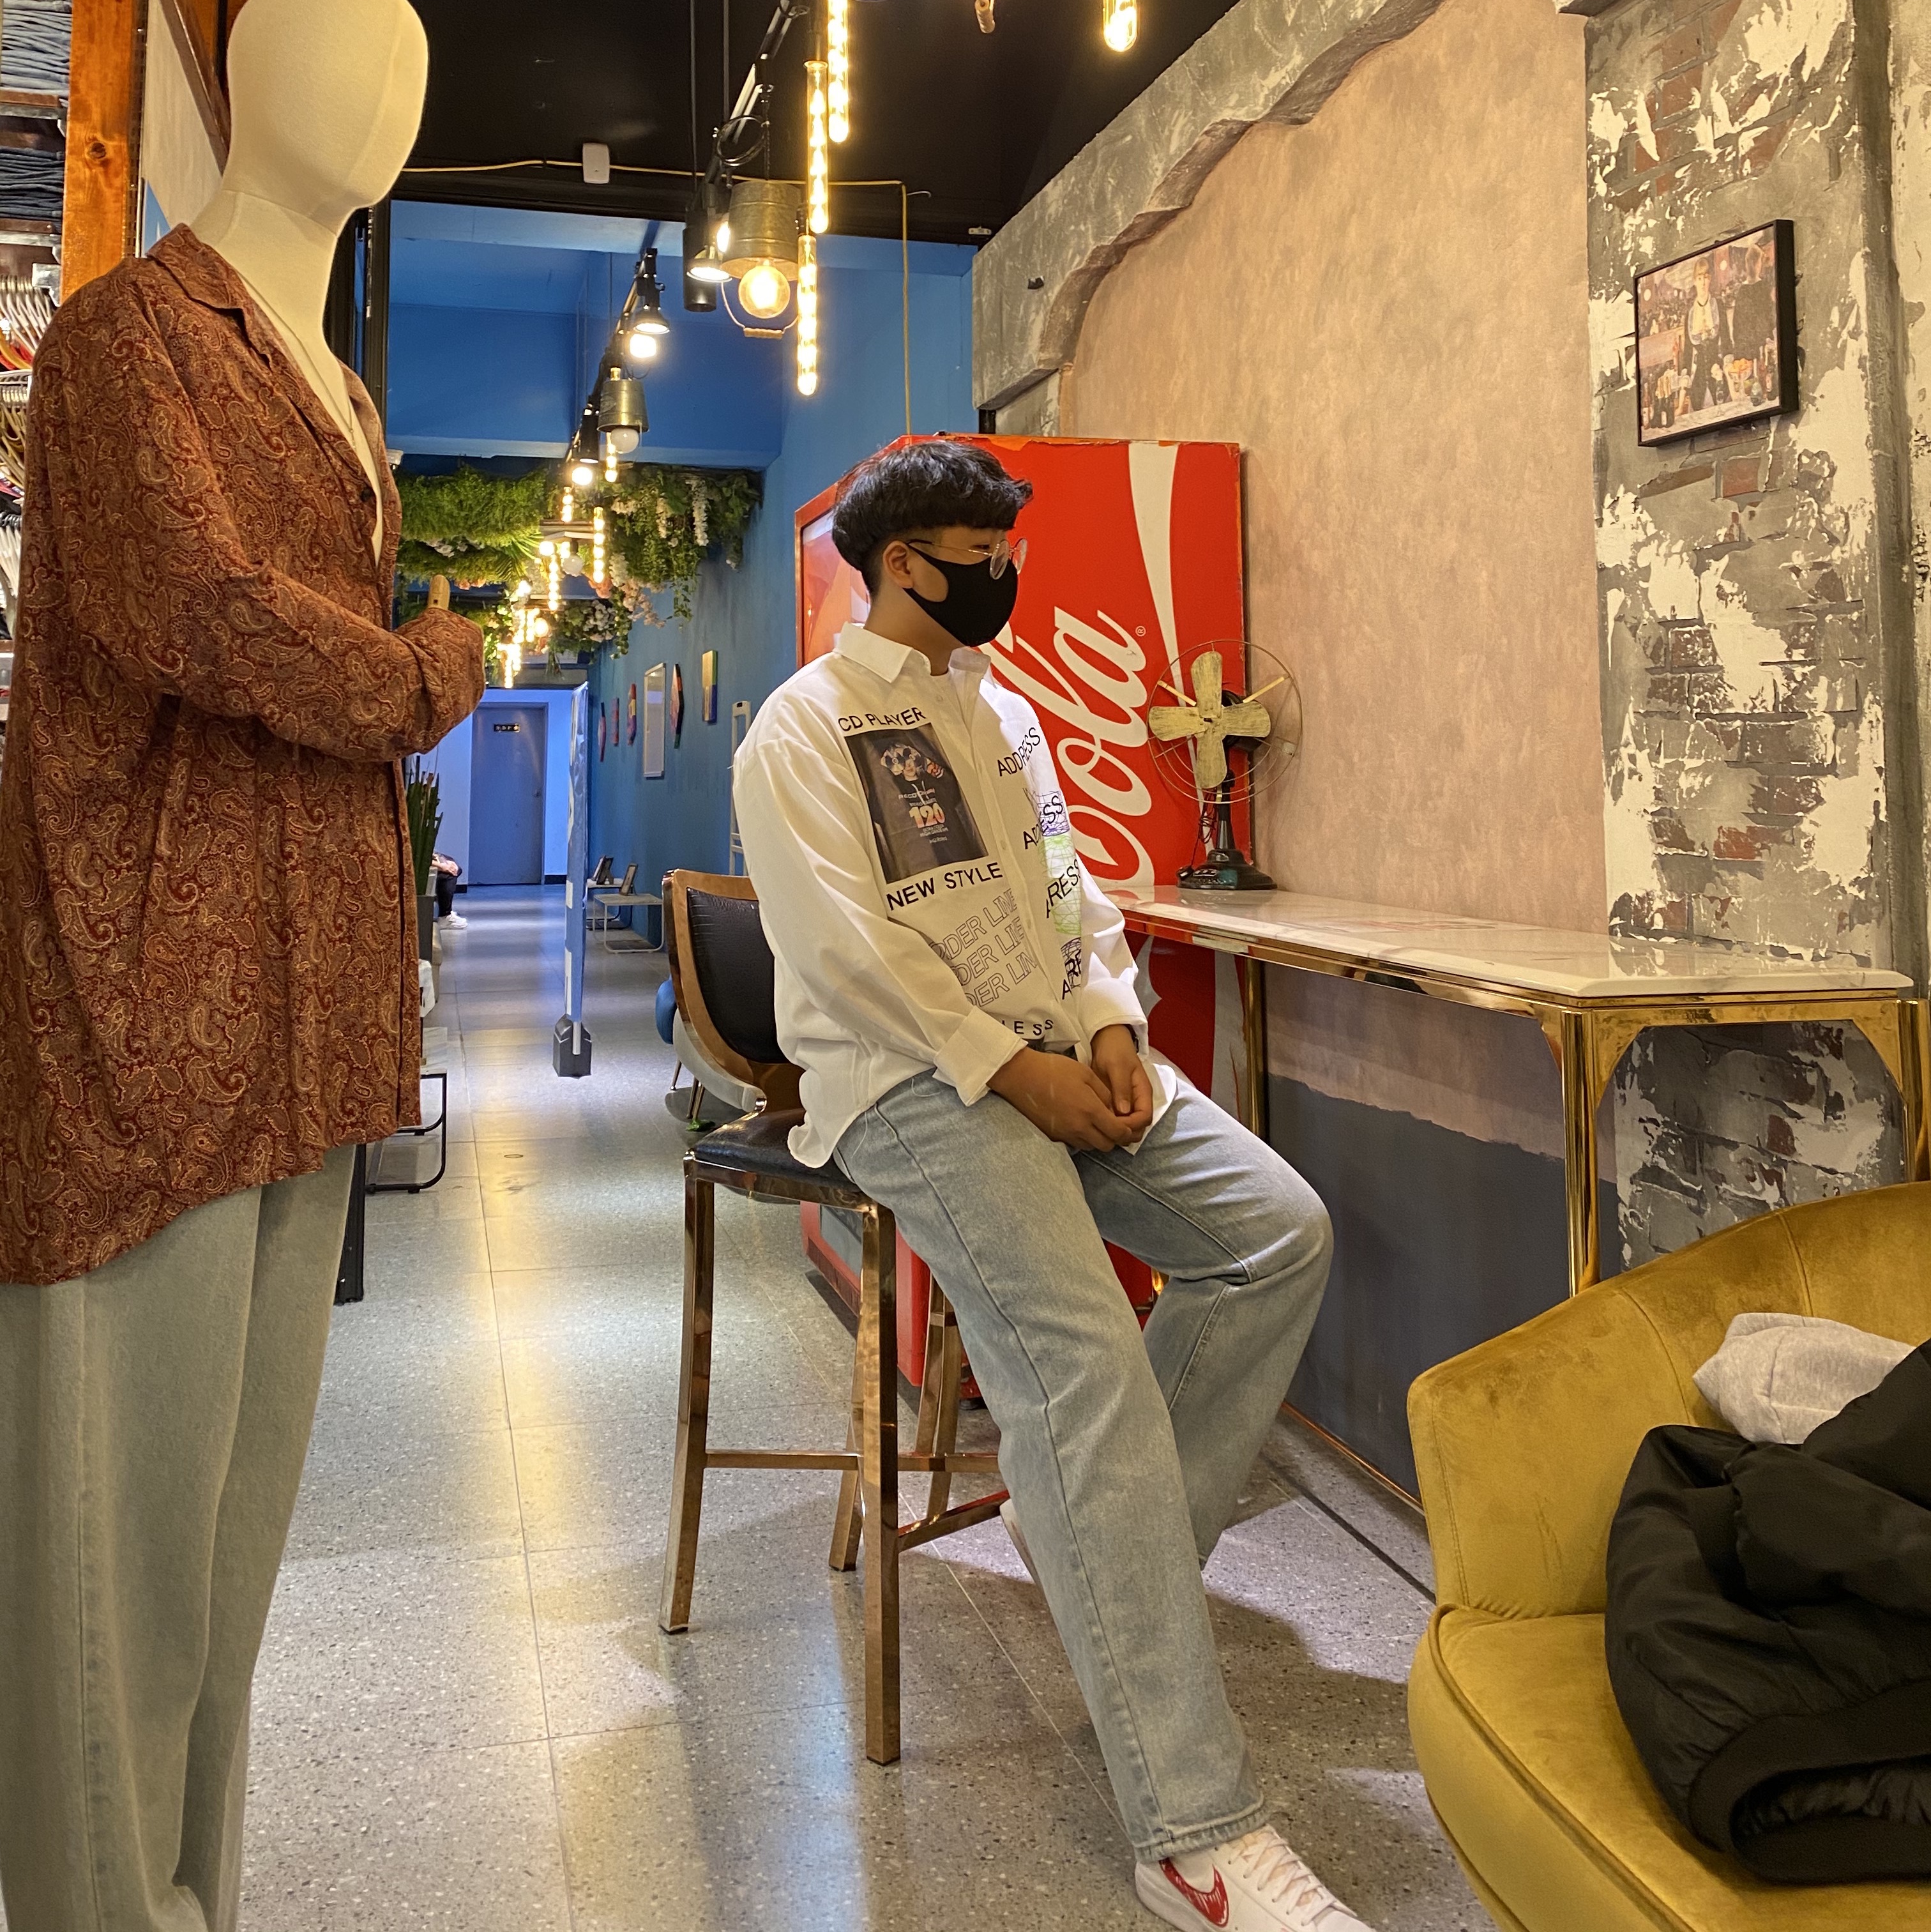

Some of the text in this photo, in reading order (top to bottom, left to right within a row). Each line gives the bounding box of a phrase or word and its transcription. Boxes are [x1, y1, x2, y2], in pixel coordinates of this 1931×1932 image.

[838, 707, 927, 731] CD PLAYER
[997, 727, 1040, 777] ADDRESS
[909, 802, 945, 828] 120
[886, 862, 1003, 911] NEW STYLE
